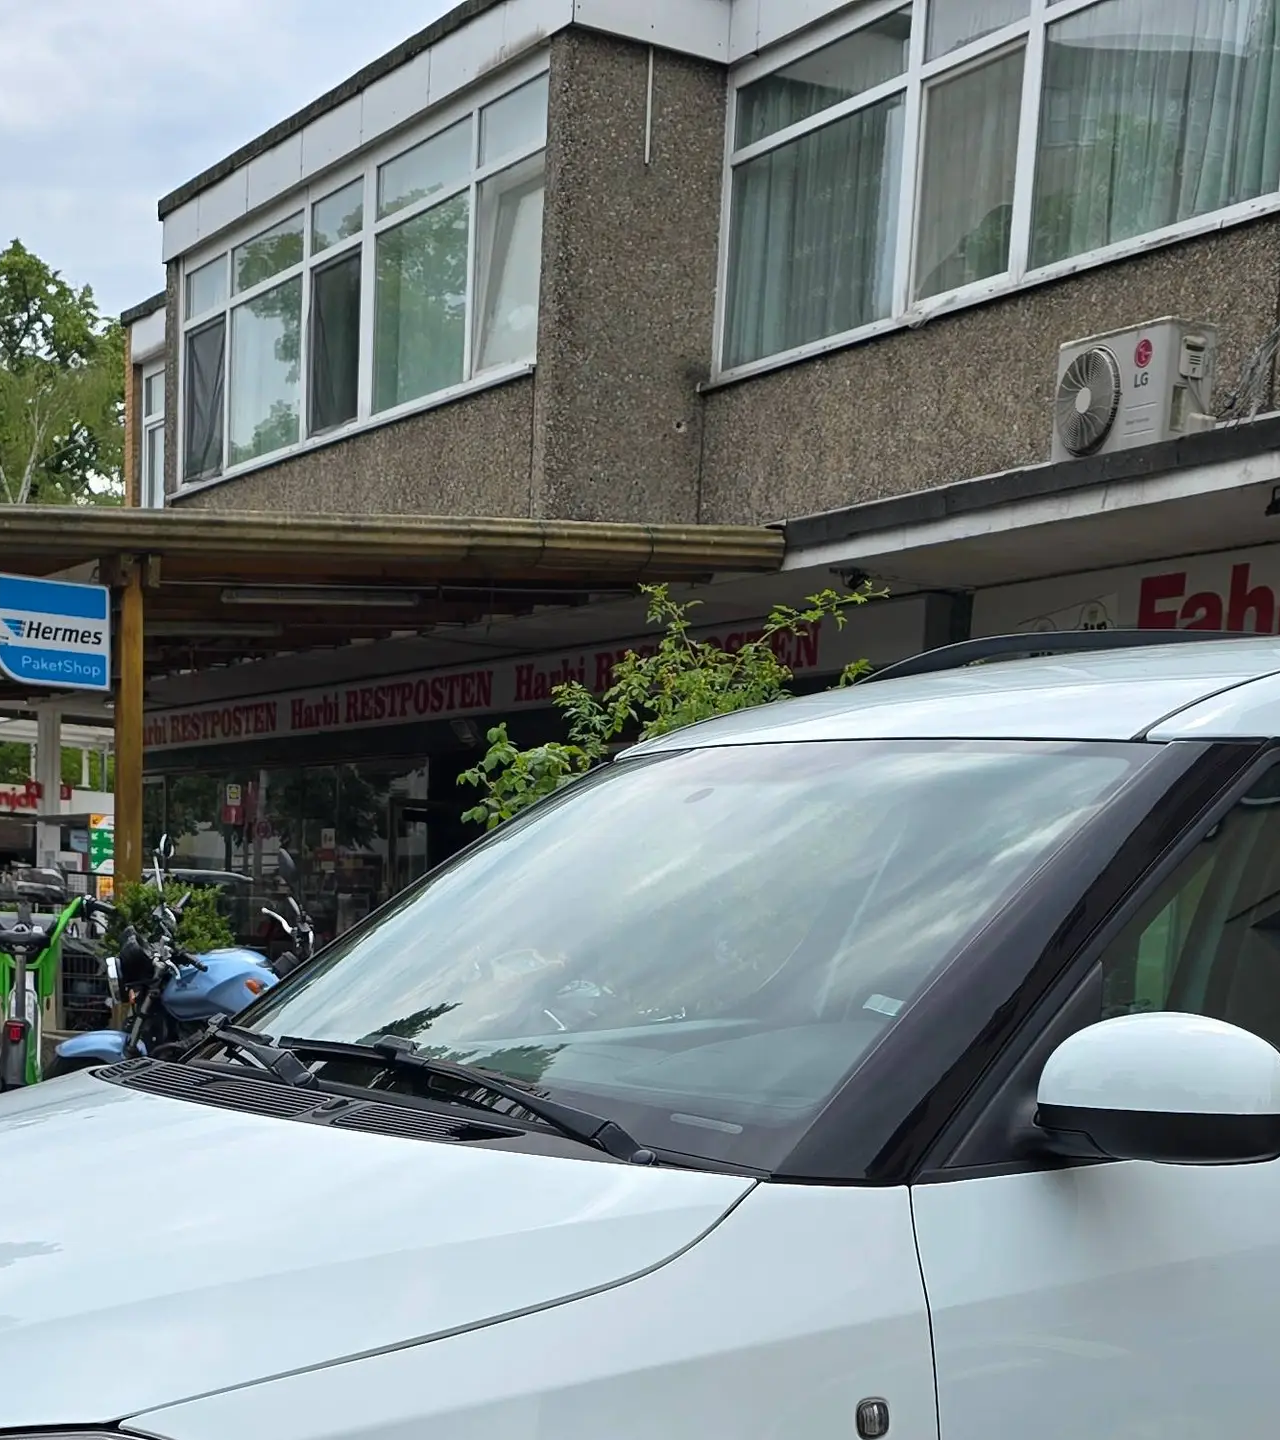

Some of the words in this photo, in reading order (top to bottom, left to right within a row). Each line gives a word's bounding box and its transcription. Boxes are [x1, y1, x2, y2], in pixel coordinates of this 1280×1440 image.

[1133, 371, 1149, 388] LG
[26, 620, 103, 645] Hermes
[21, 655, 101, 677] PaketShop
[171, 700, 278, 743] RESTPOSTEN
[290, 692, 340, 731] Harbi
[344, 669, 494, 724] RESTPOSTEN
